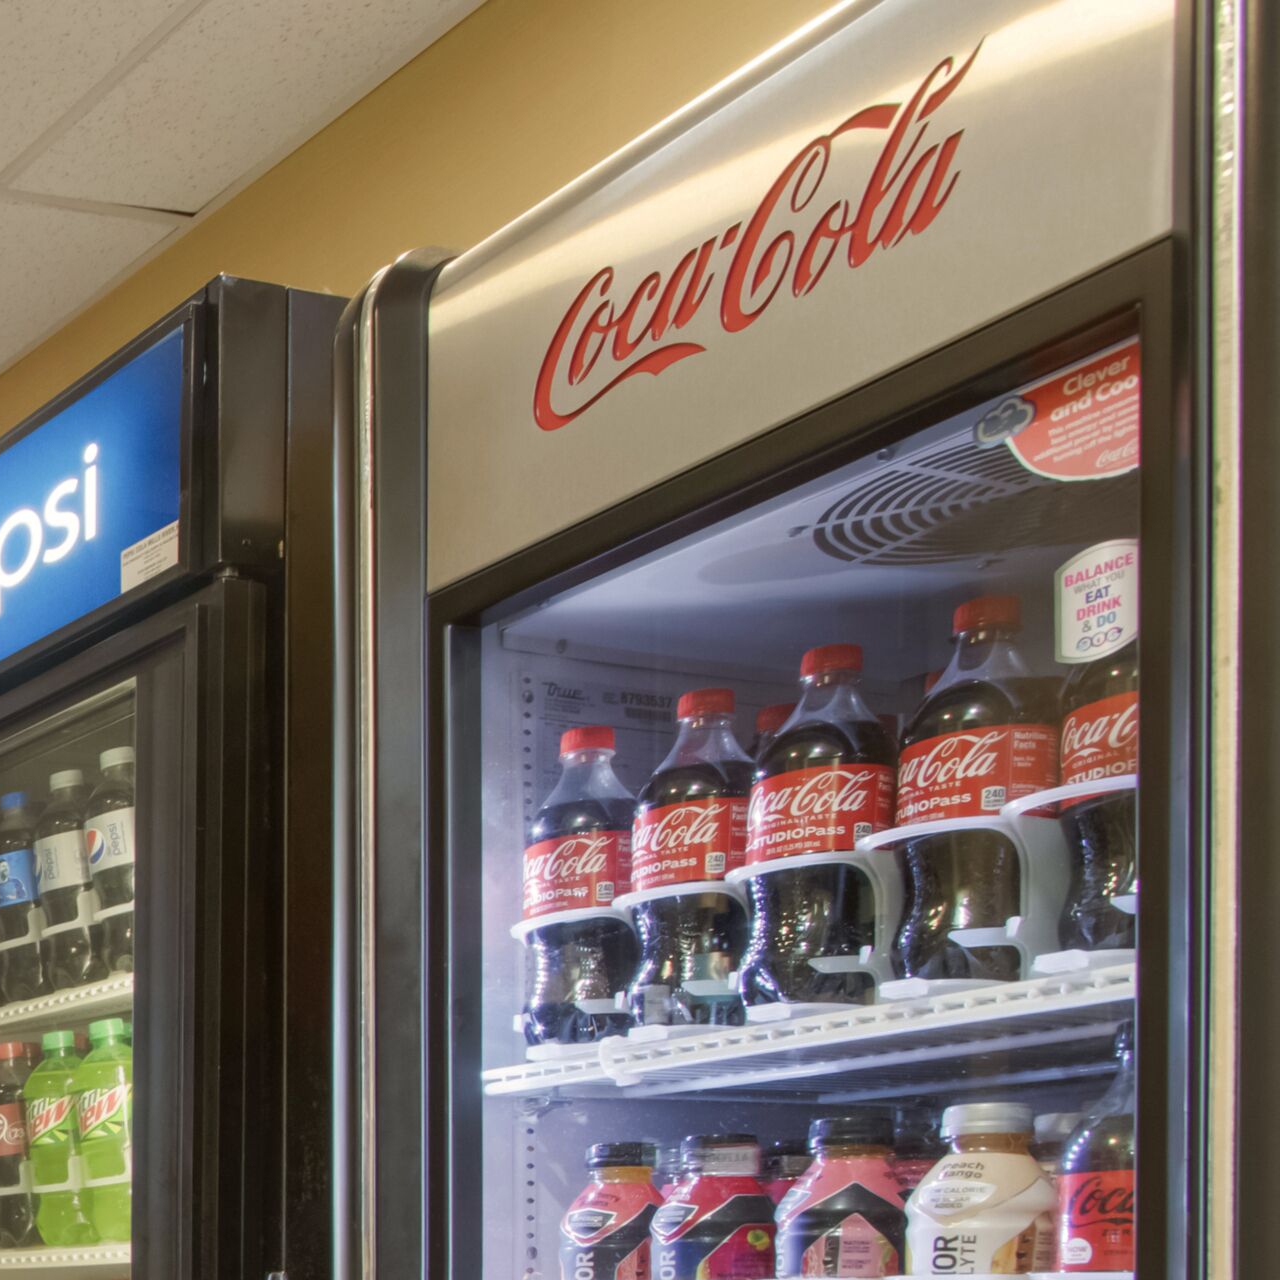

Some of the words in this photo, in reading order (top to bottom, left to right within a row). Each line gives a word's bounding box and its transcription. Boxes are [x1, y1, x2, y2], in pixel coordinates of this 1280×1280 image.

[533, 34, 986, 431] Coca-Cola
[1063, 356, 1131, 396] Clever
[1050, 389, 1093, 422] and
[1064, 551, 1134, 588] BALANCE
[1075, 596, 1123, 622] DRINK
[1085, 585, 1111, 605] EAT
[1082, 619, 1094, 634] &
[1096, 611, 1118, 628] DO
[898, 731, 1009, 788] ca-Cola
[747, 770, 876, 833] Coca-Cola
[896, 792, 972, 821] TUDIOPass
[984, 788, 1005, 800] 240
[632, 803, 728, 852] ca-Cola
[523, 836, 614, 881] ca-Cola
[943, 1170, 983, 1180] ango
